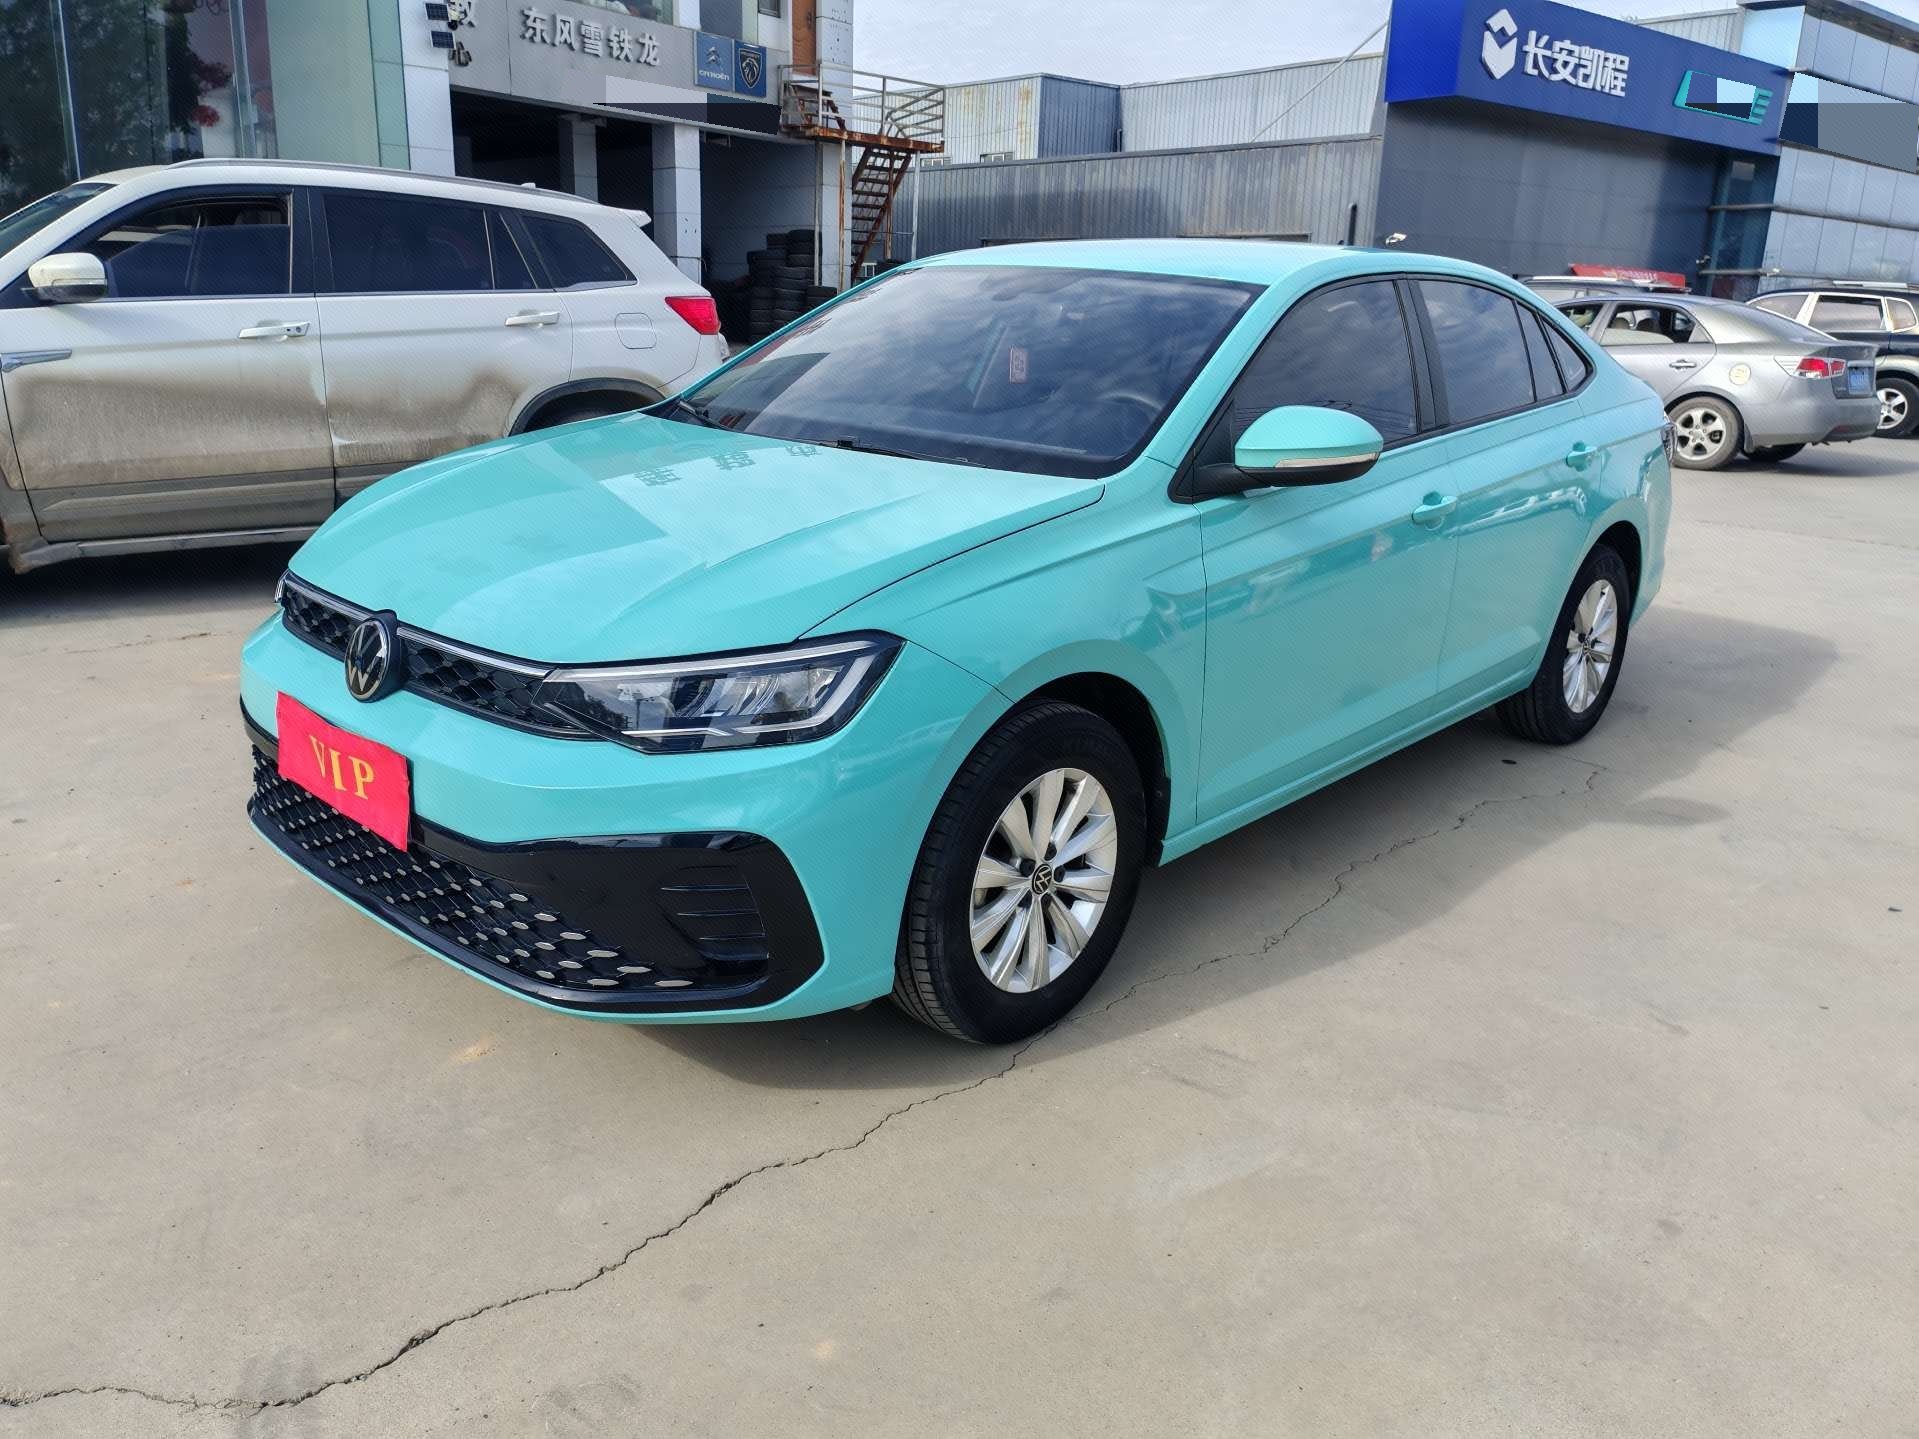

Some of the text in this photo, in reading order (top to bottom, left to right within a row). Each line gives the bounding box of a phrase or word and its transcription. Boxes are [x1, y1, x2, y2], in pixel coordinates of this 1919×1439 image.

[521, 6, 661, 66] 东风雪铁龙
[1522, 30, 1630, 97] 长安凯程
[309, 735, 375, 800] VIP
